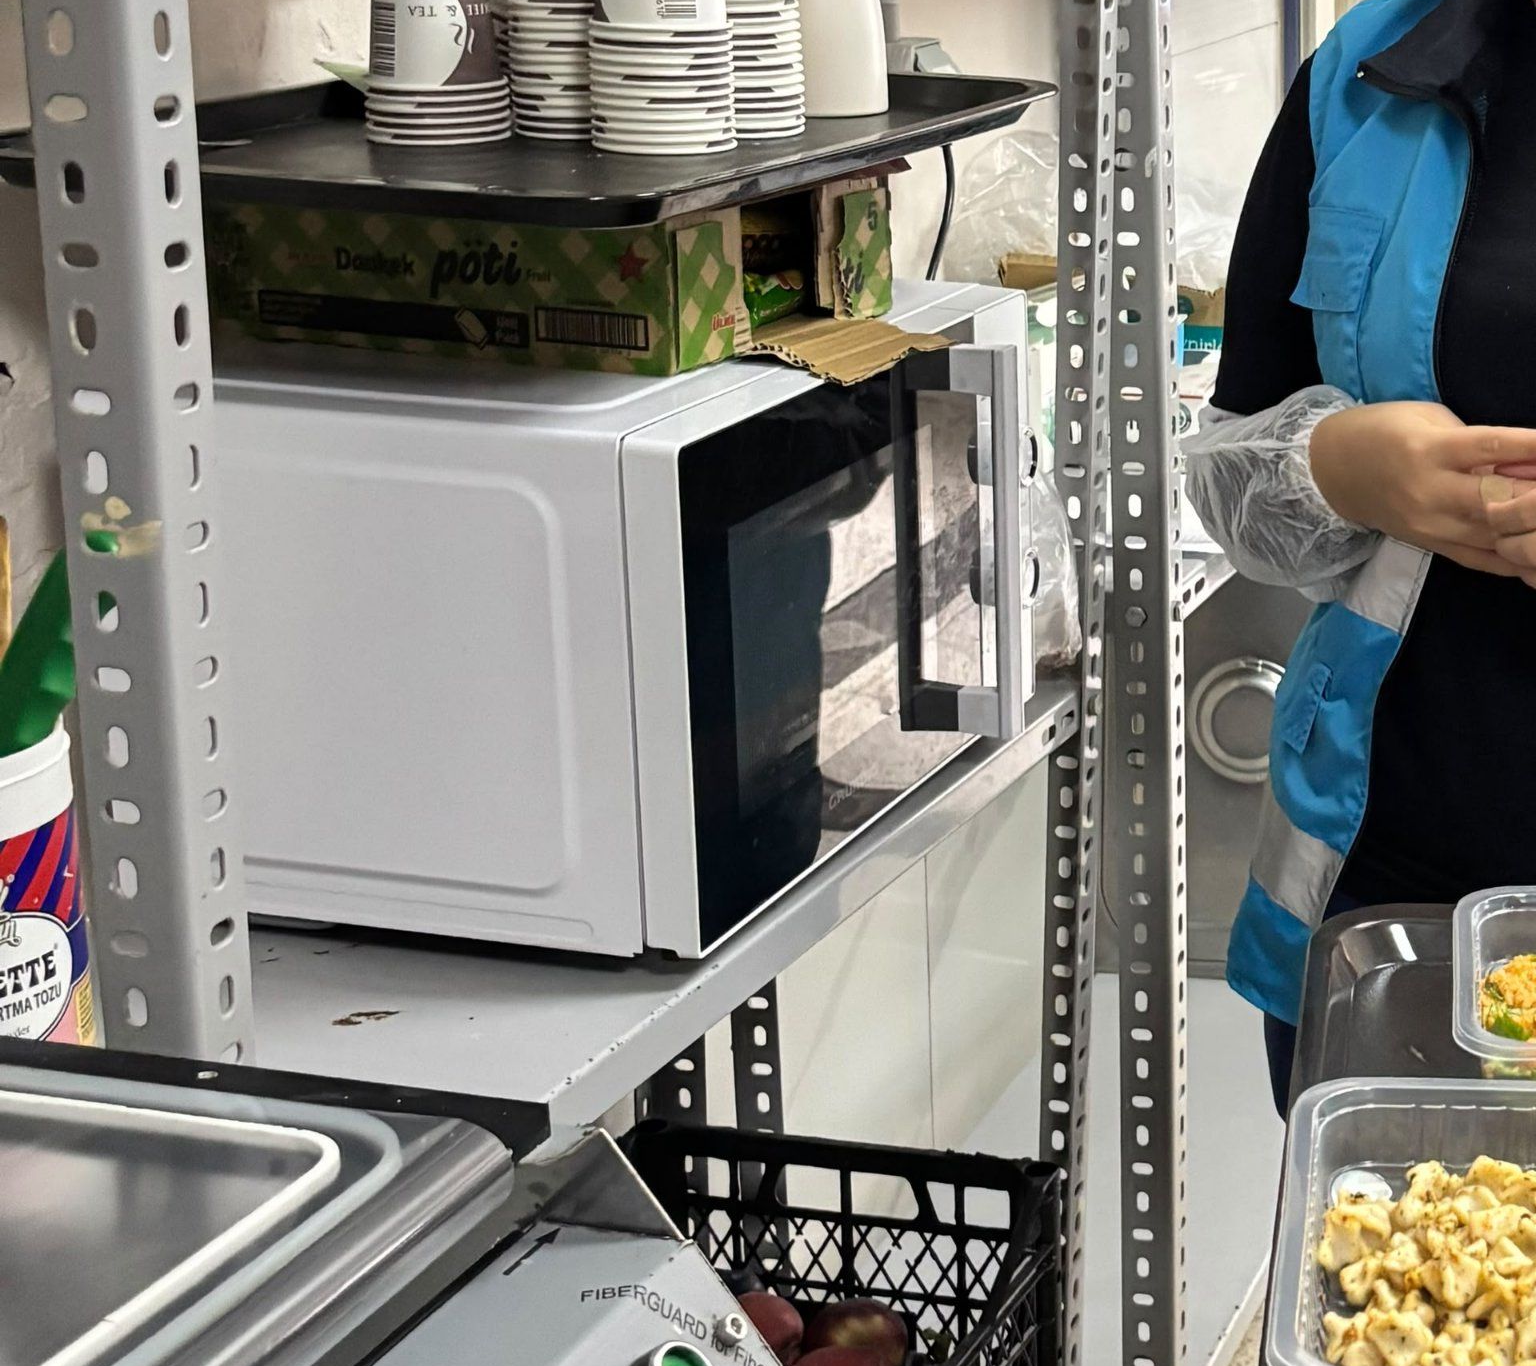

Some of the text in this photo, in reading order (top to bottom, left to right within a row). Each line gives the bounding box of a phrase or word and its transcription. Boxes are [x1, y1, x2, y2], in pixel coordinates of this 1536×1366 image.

[407, 5, 438, 18] TEA
[429, 238, 522, 299] pöti
[33, 981, 63, 1010] TOZU
[580, 1284, 708, 1341] FIBERGUARD
